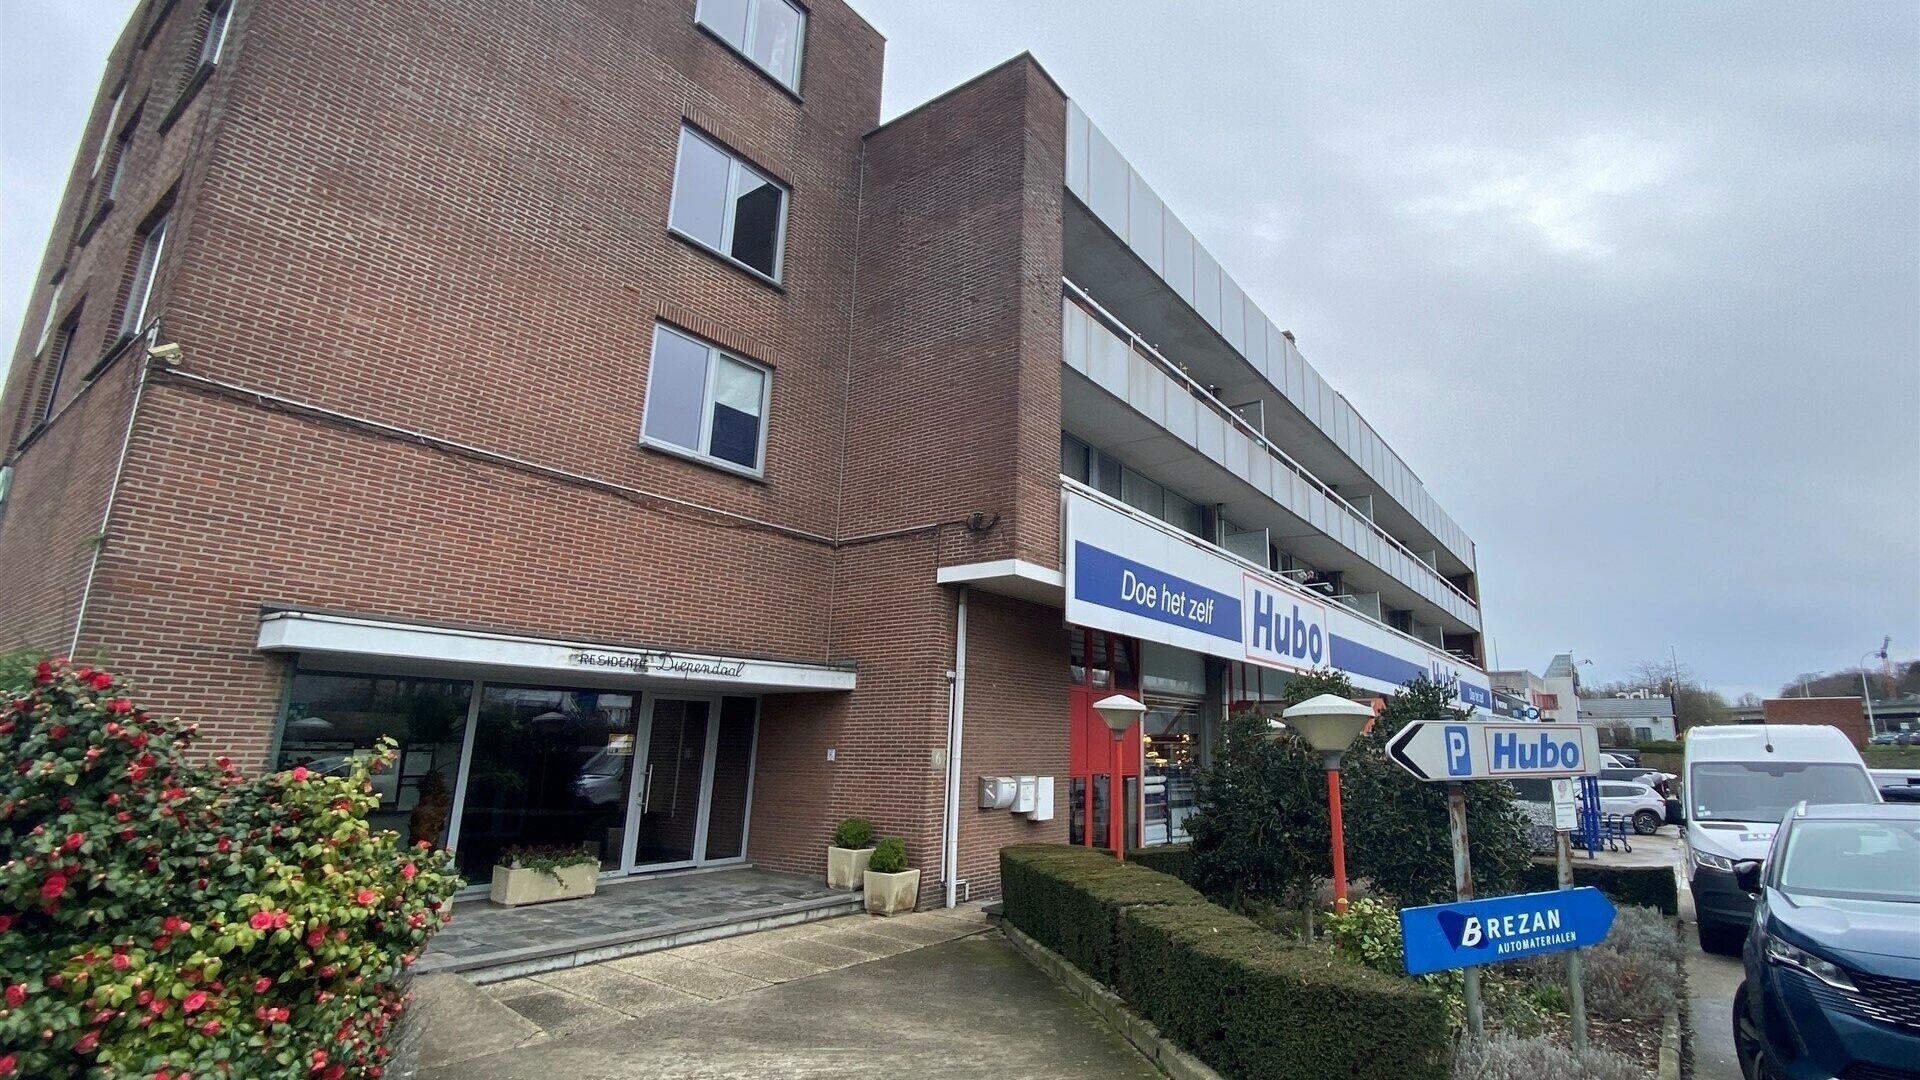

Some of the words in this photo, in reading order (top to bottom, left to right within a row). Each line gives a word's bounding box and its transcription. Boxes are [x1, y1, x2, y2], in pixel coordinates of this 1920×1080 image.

[1121, 569, 1157, 608] Doe
[1161, 583, 1185, 617] het
[1188, 598, 1214, 625] zelf
[1253, 589, 1323, 664] Hubo
[655, 652, 746, 681] Diependaal
[1449, 732, 1466, 770] P
[1493, 732, 1580, 769] Hubo
[1461, 909, 1561, 947] BREZAN
[1498, 931, 1577, 954] AUTOMATERIALEN
